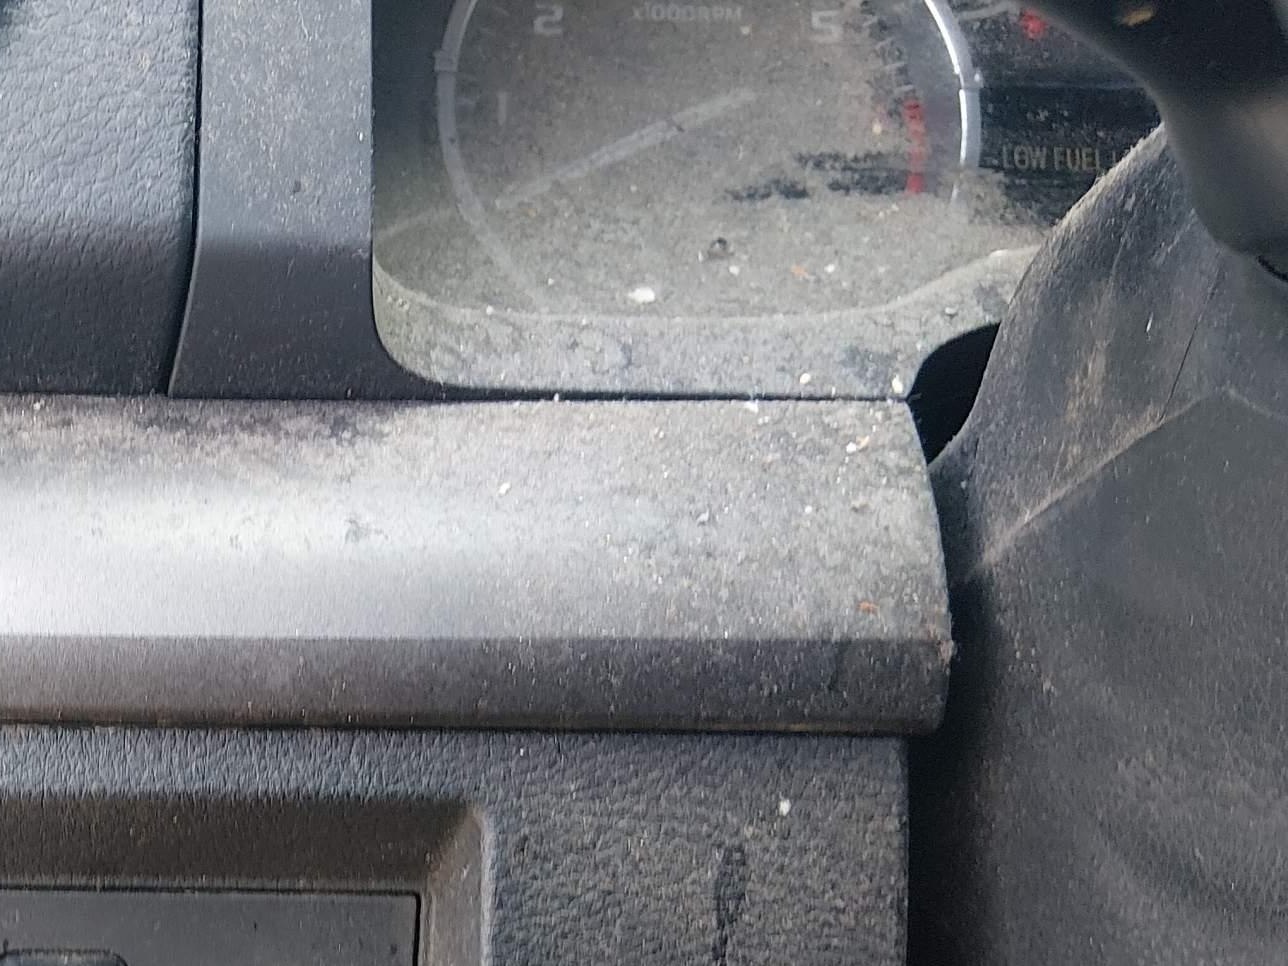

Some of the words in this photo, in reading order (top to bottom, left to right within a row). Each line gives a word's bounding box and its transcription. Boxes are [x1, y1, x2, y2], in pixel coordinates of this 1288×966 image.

[533, 3, 563, 36] 2
[811, 9, 844, 44] 5
[1001, 144, 1047, 170] LOW
[1053, 145, 1101, 171] FUEL
